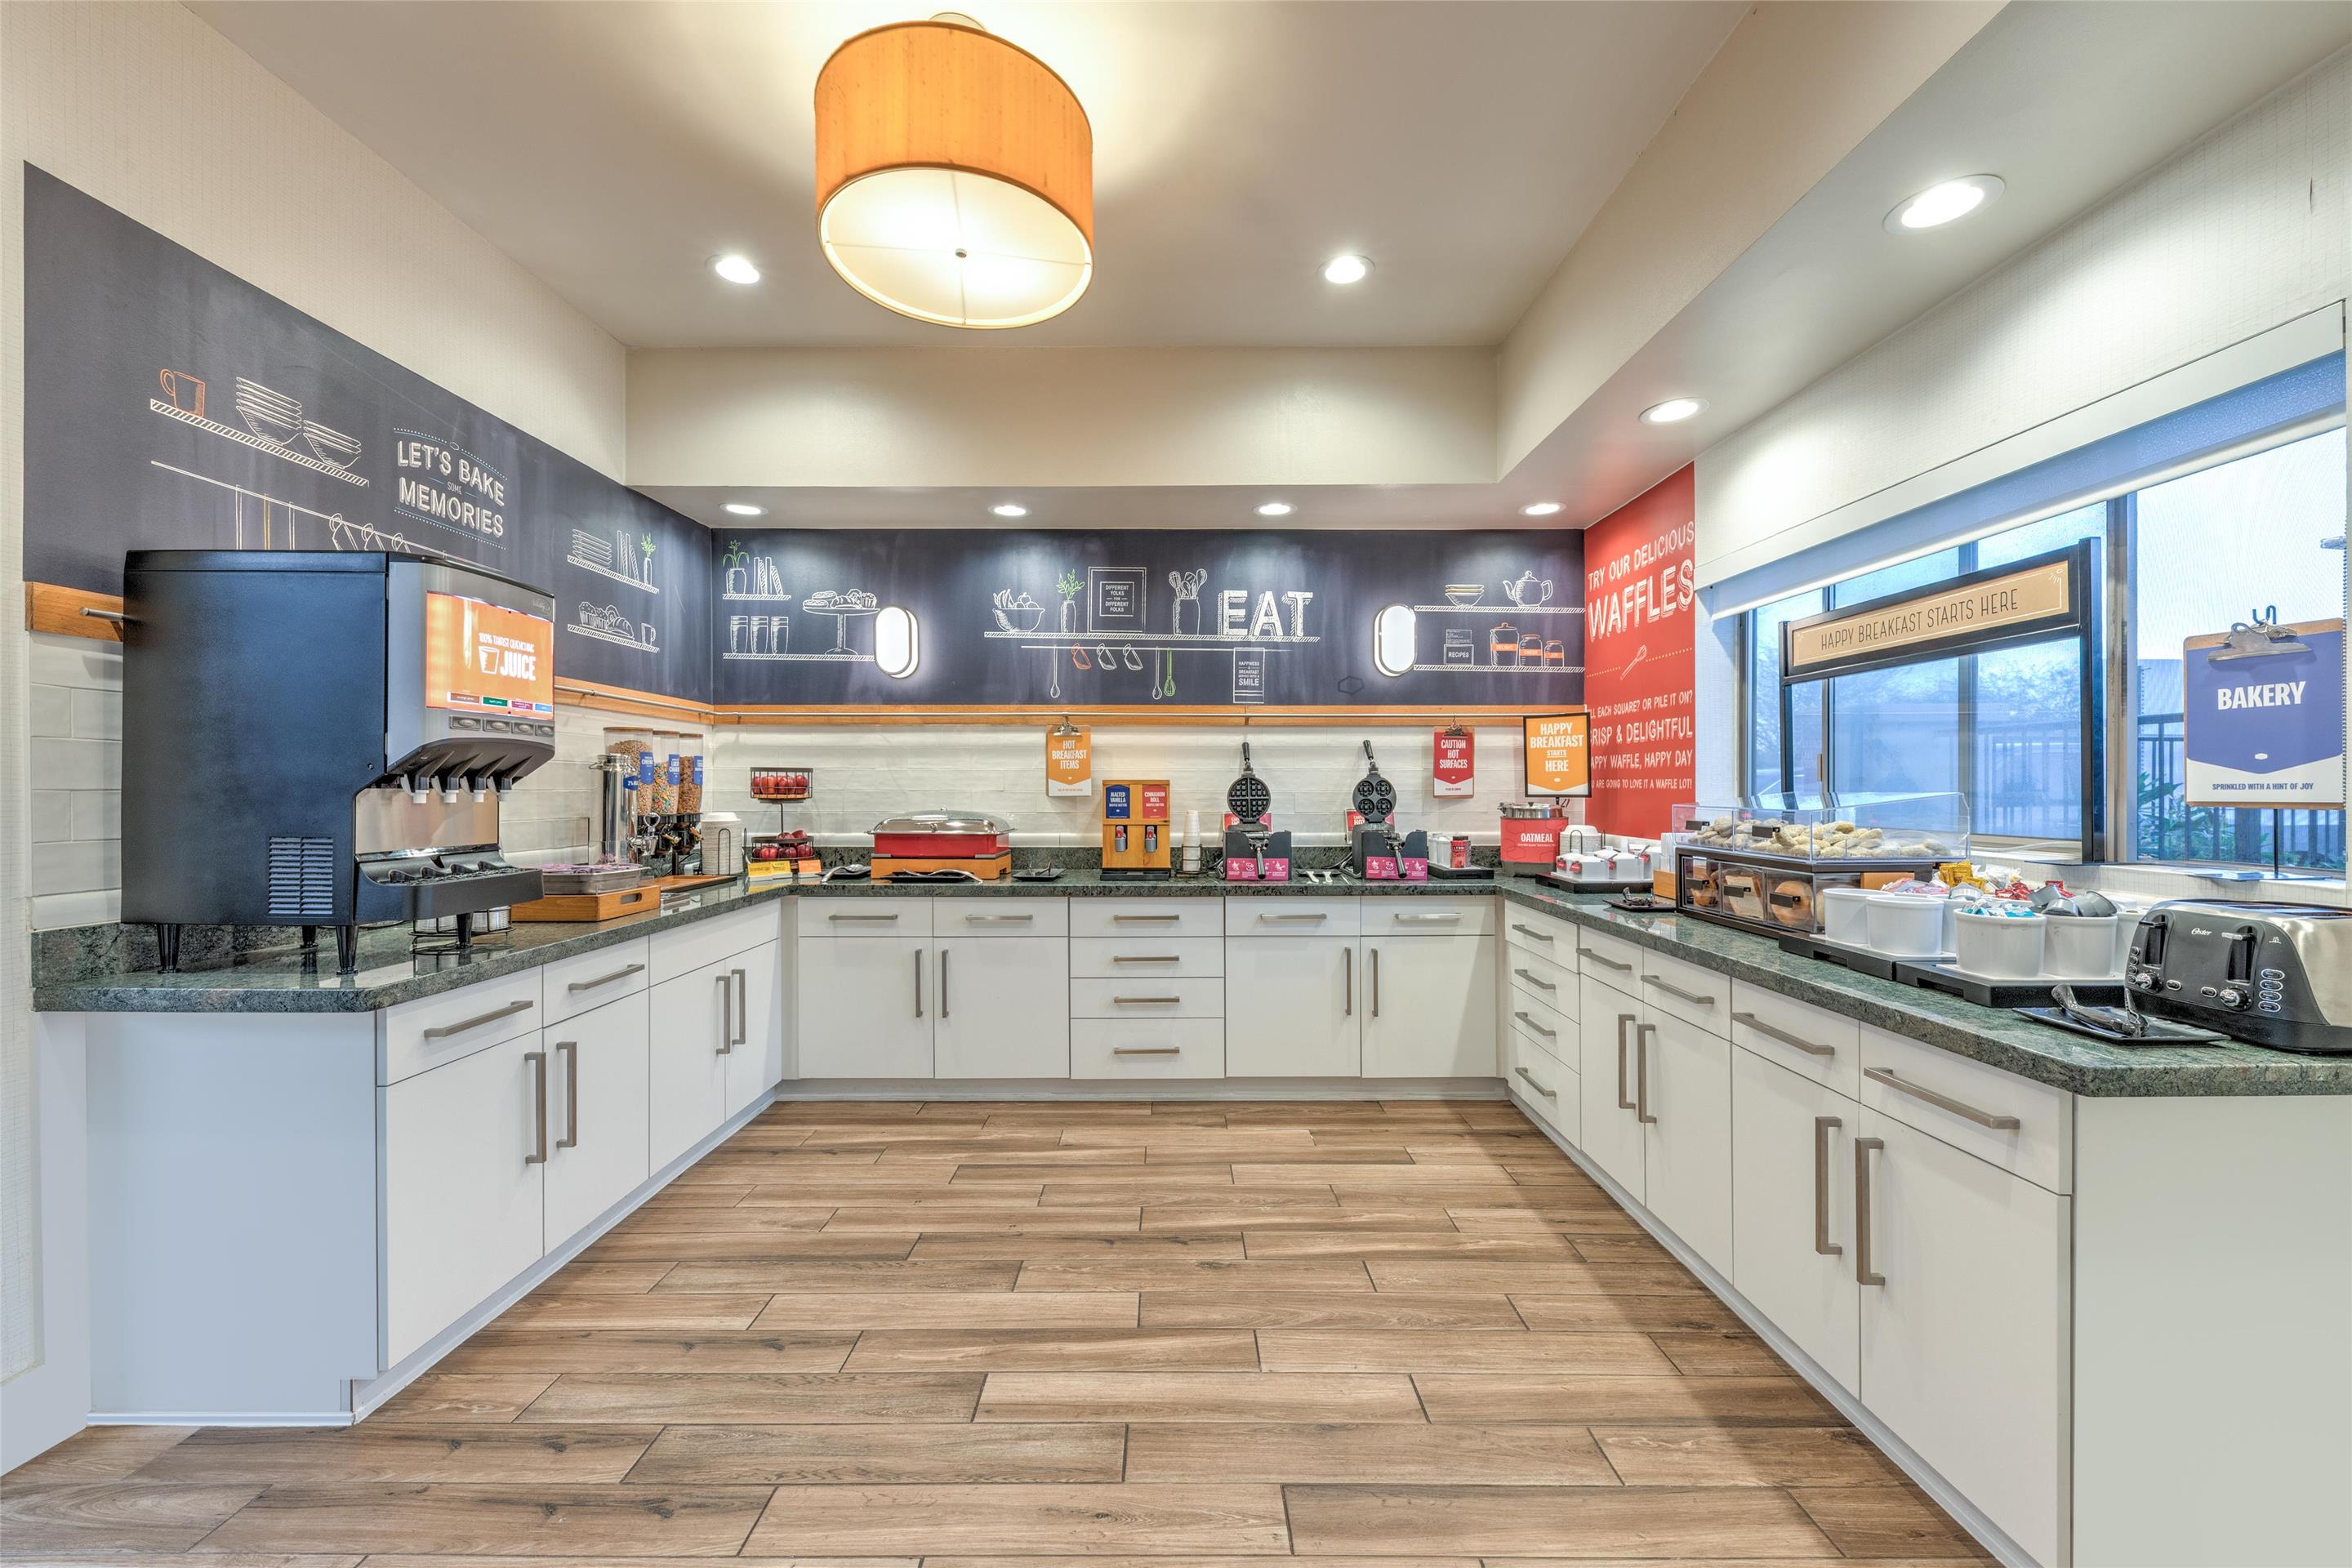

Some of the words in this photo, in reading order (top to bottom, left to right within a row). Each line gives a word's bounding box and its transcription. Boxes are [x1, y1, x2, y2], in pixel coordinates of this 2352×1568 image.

[398, 441, 452, 476] LET'S
[459, 459, 505, 507] BAKE
[448, 481, 462, 495] SOME
[399, 476, 504, 538] MEMORIES
[1588, 566, 1606, 592] TRY
[1609, 555, 1631, 581] OUR
[1634, 521, 1695, 572] DELICIOUS
[1588, 559, 1695, 643] WAFFLES
[1218, 590, 1314, 638] EAT
[1821, 626, 1855, 651] HAPPY
[1858, 611, 1922, 644] BREAKFAST
[1927, 599, 1974, 628] STARTS
[1980, 588, 2018, 617] HERE
[500, 650, 537, 681] JUICE
[1238, 678, 1260, 686] SMILE
[2217, 680, 2306, 710] BAKERY
[1597, 705, 1612, 719] EACH
[1613, 699, 1641, 716] SQUARE?
[1642, 697, 1652, 711] OR
[1654, 694, 1668, 709] PILE
[1670, 693, 1677, 706] IT
[1678, 689, 1693, 705] ON?
[1540, 722, 1573, 735] HAPPY
[1616, 724, 1623, 744] &
[1626, 715, 1693, 745] DELIGHTFUL
[1062, 740, 1076, 750] HOT
[1441, 739, 1467, 750] CAUTION
[1530, 734, 1584, 749] BREAKFAST
[1052, 750, 1087, 760] BREAKFAST
[1447, 749, 1459, 759] HOT
[1546, 750, 1567, 758] STARTS
[1590, 755, 1608, 770] APPY
[1610, 753, 1642, 769] WAFFLE,
[1644, 751, 1672, 768] HAPPY
[1675, 749, 1693, 767] DAY
[1060, 760, 1080, 769] ITEMS
[1439, 759, 1468, 769] SURFACES
[1545, 759, 1569, 773] HERE
[1596, 779, 1605, 789] ARE
[1606, 779, 1620, 789] GOING
[1622, 779, 1628, 789] TO
[1630, 778, 1642, 789] LOVE
[1643, 778, 1648, 789] IT
[1650, 779, 1654, 789] A
[1655, 778, 1677, 789] WAFFLE
[1679, 777, 1692, 789] LOT!
[1521, 832, 1554, 843] OATMEAL
[2191, 927, 2212, 936] Oster
